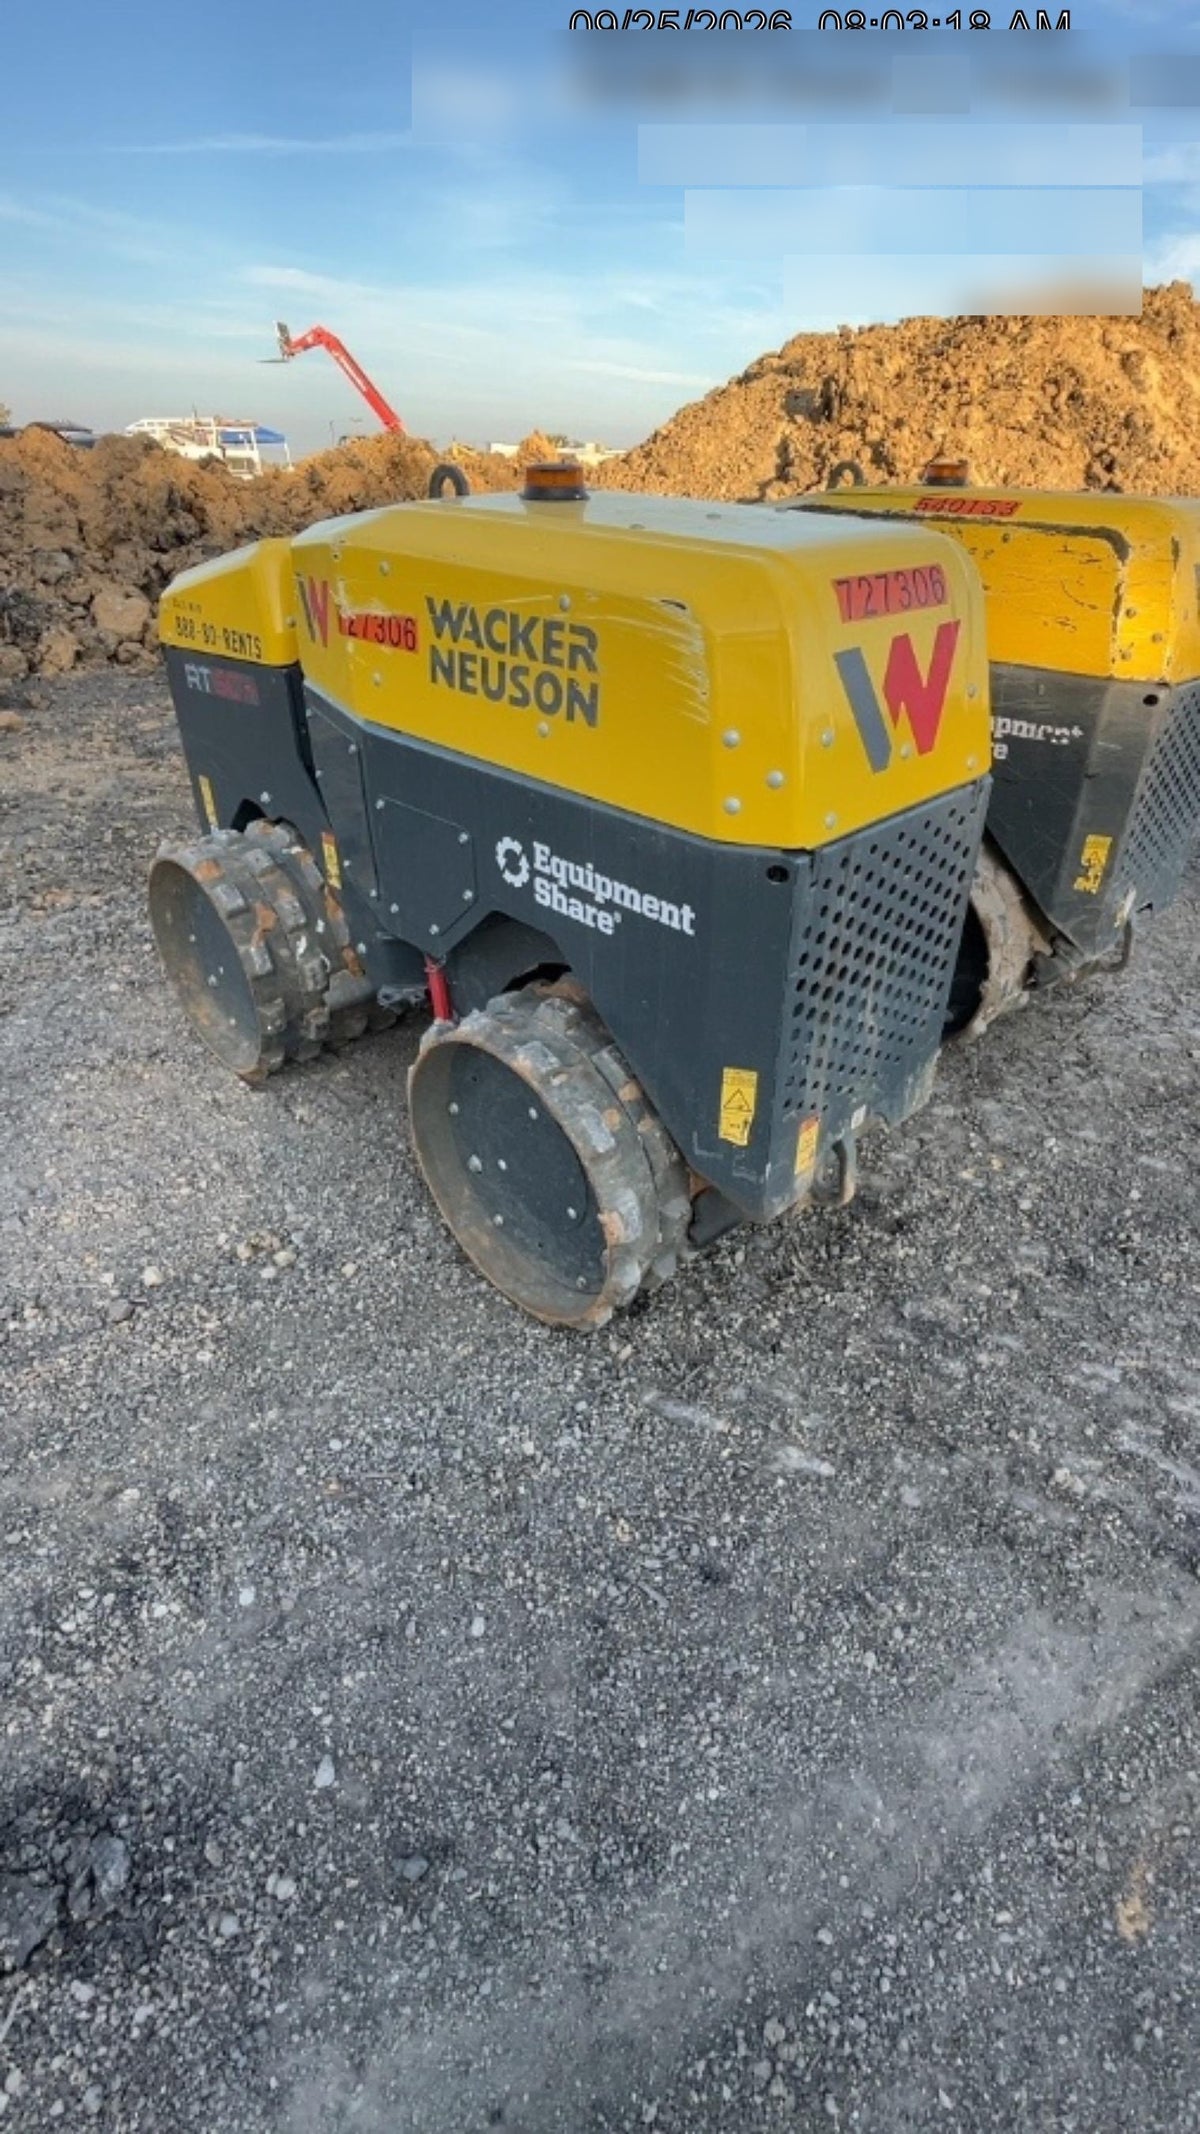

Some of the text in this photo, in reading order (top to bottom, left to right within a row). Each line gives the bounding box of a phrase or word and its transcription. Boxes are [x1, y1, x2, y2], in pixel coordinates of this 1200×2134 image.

[836, 565, 946, 619] 727306
[425, 595, 599, 674] WACKER
[428, 643, 599, 728] NEUSON
[533, 840, 696, 937] Equipment
